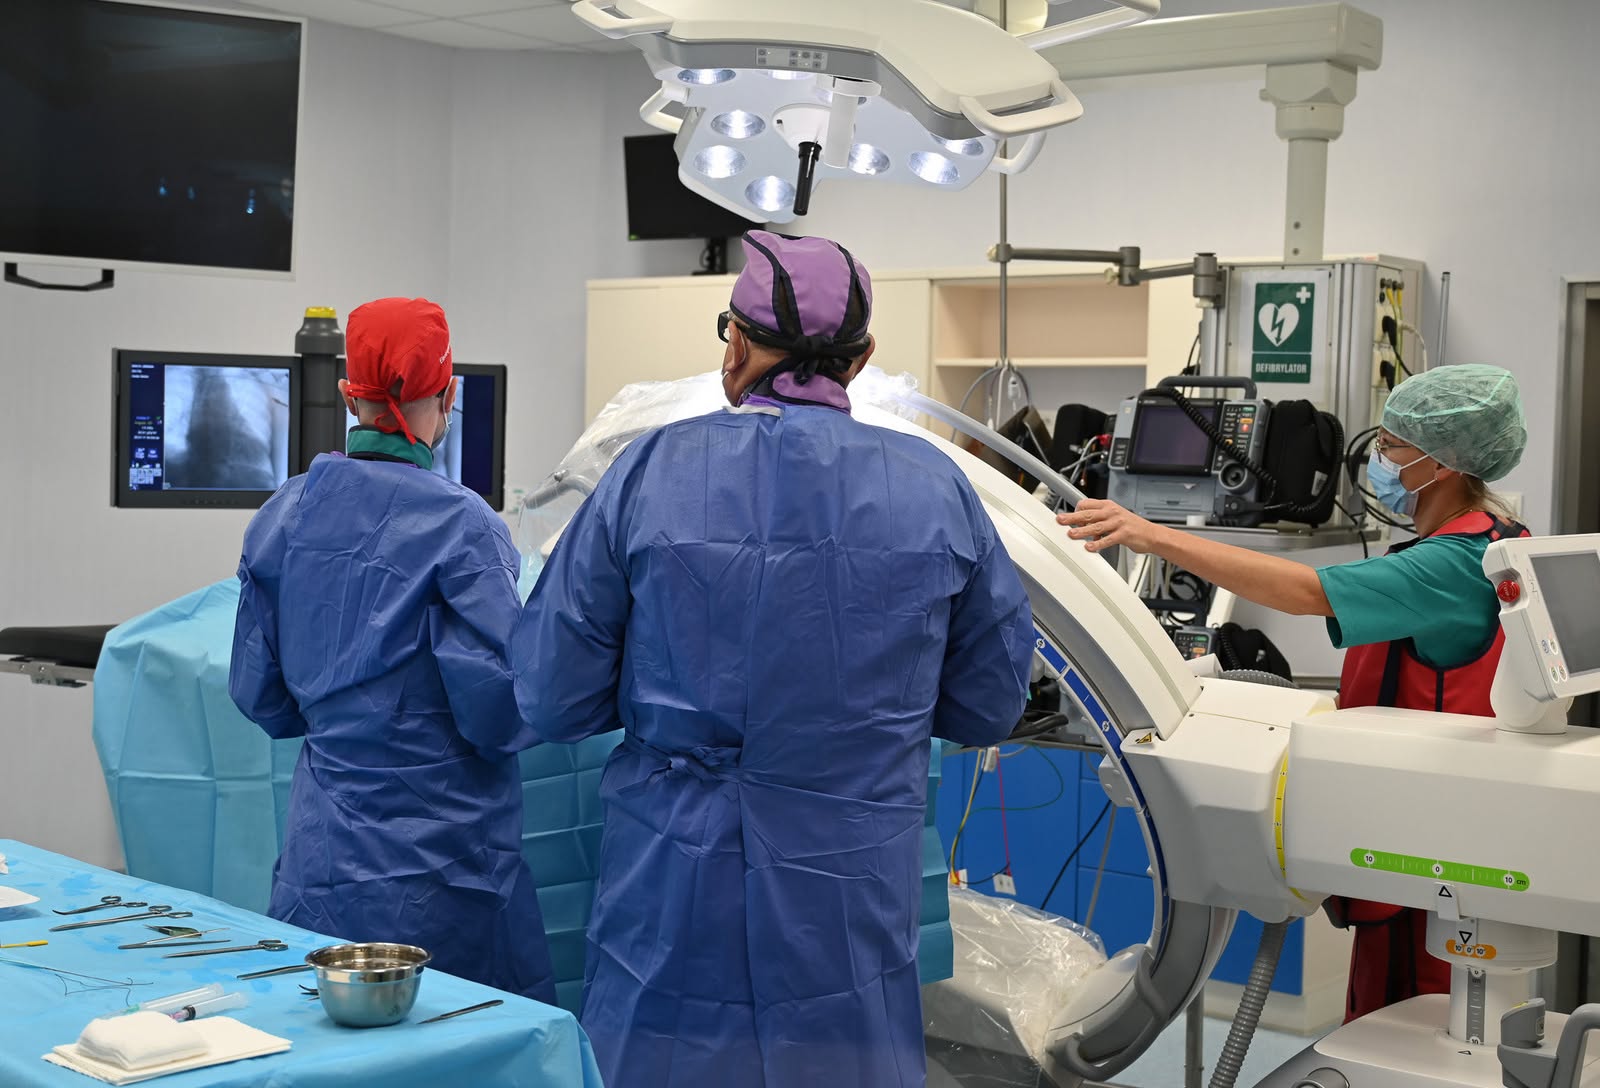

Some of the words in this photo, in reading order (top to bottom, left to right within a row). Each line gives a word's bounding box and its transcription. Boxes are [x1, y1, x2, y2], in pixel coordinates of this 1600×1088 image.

[1255, 363, 1307, 374] DEFIBRYLATOR
[1365, 854, 1373, 862] 10
[1505, 875, 1513, 884] 10
